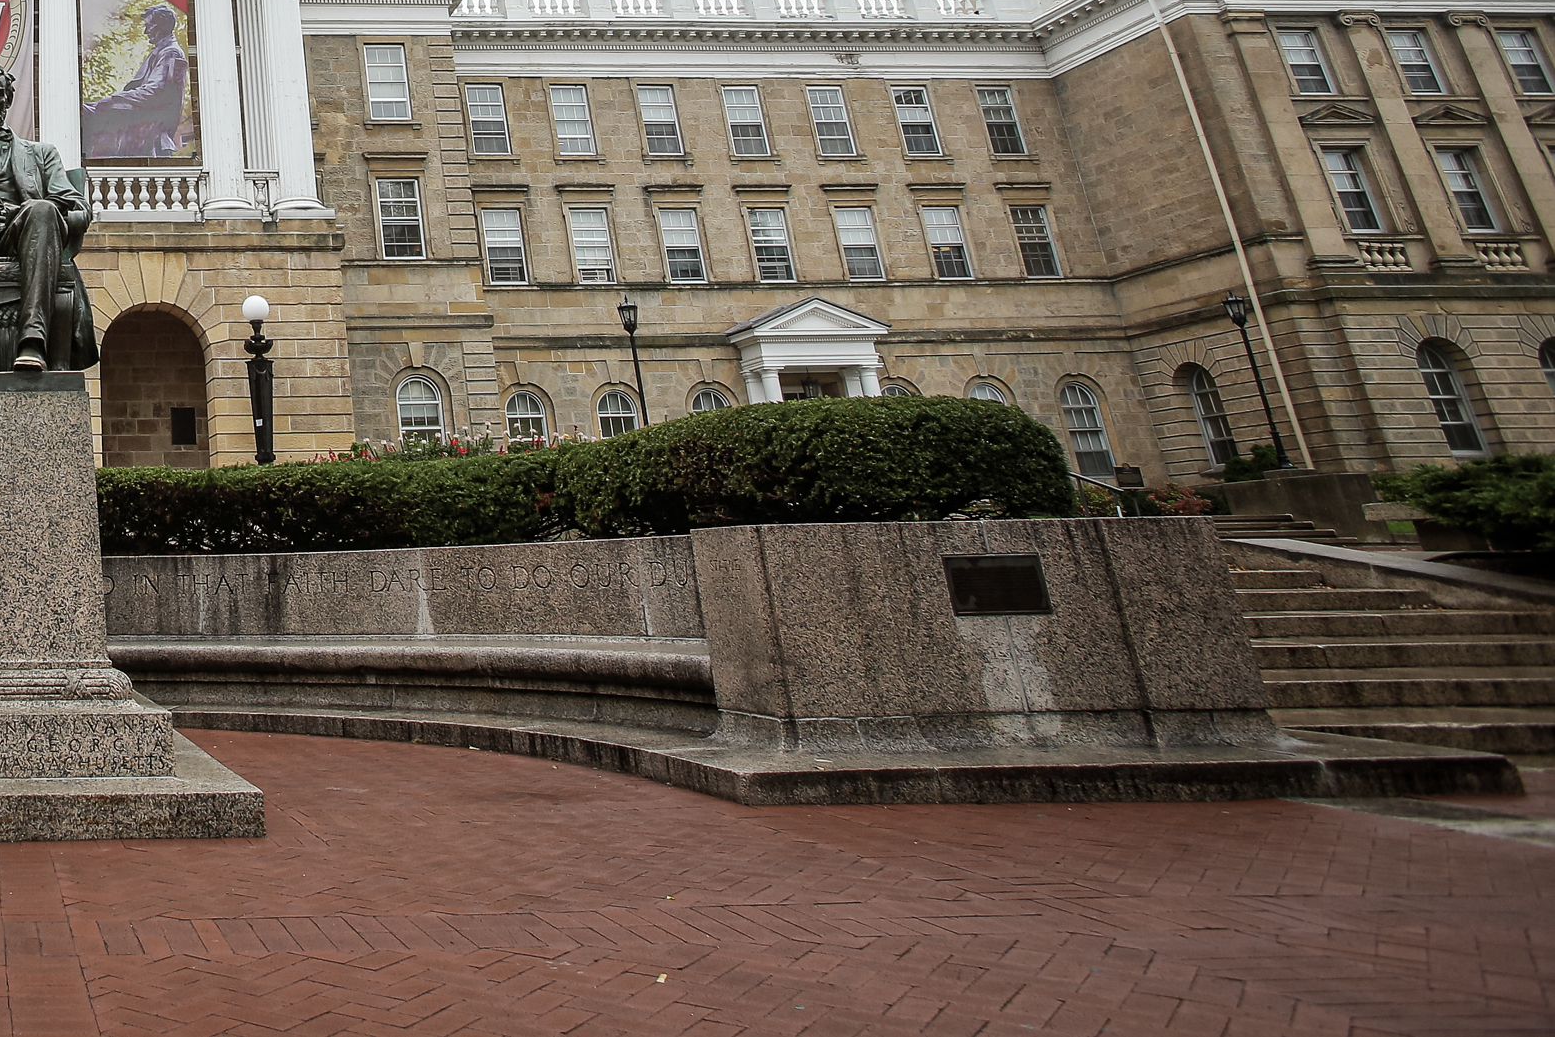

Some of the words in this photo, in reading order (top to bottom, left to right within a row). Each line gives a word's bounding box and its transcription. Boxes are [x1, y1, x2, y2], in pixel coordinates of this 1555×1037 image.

[134, 574, 160, 595] IN
[178, 573, 249, 595] THAT
[266, 572, 349, 594] FAITH
[368, 568, 447, 593] DARE
[460, 566, 497, 590] TO
[511, 565, 552, 590] DO
[570, 562, 639, 589] OUR
[26, 738, 166, 753] GEORGIA
